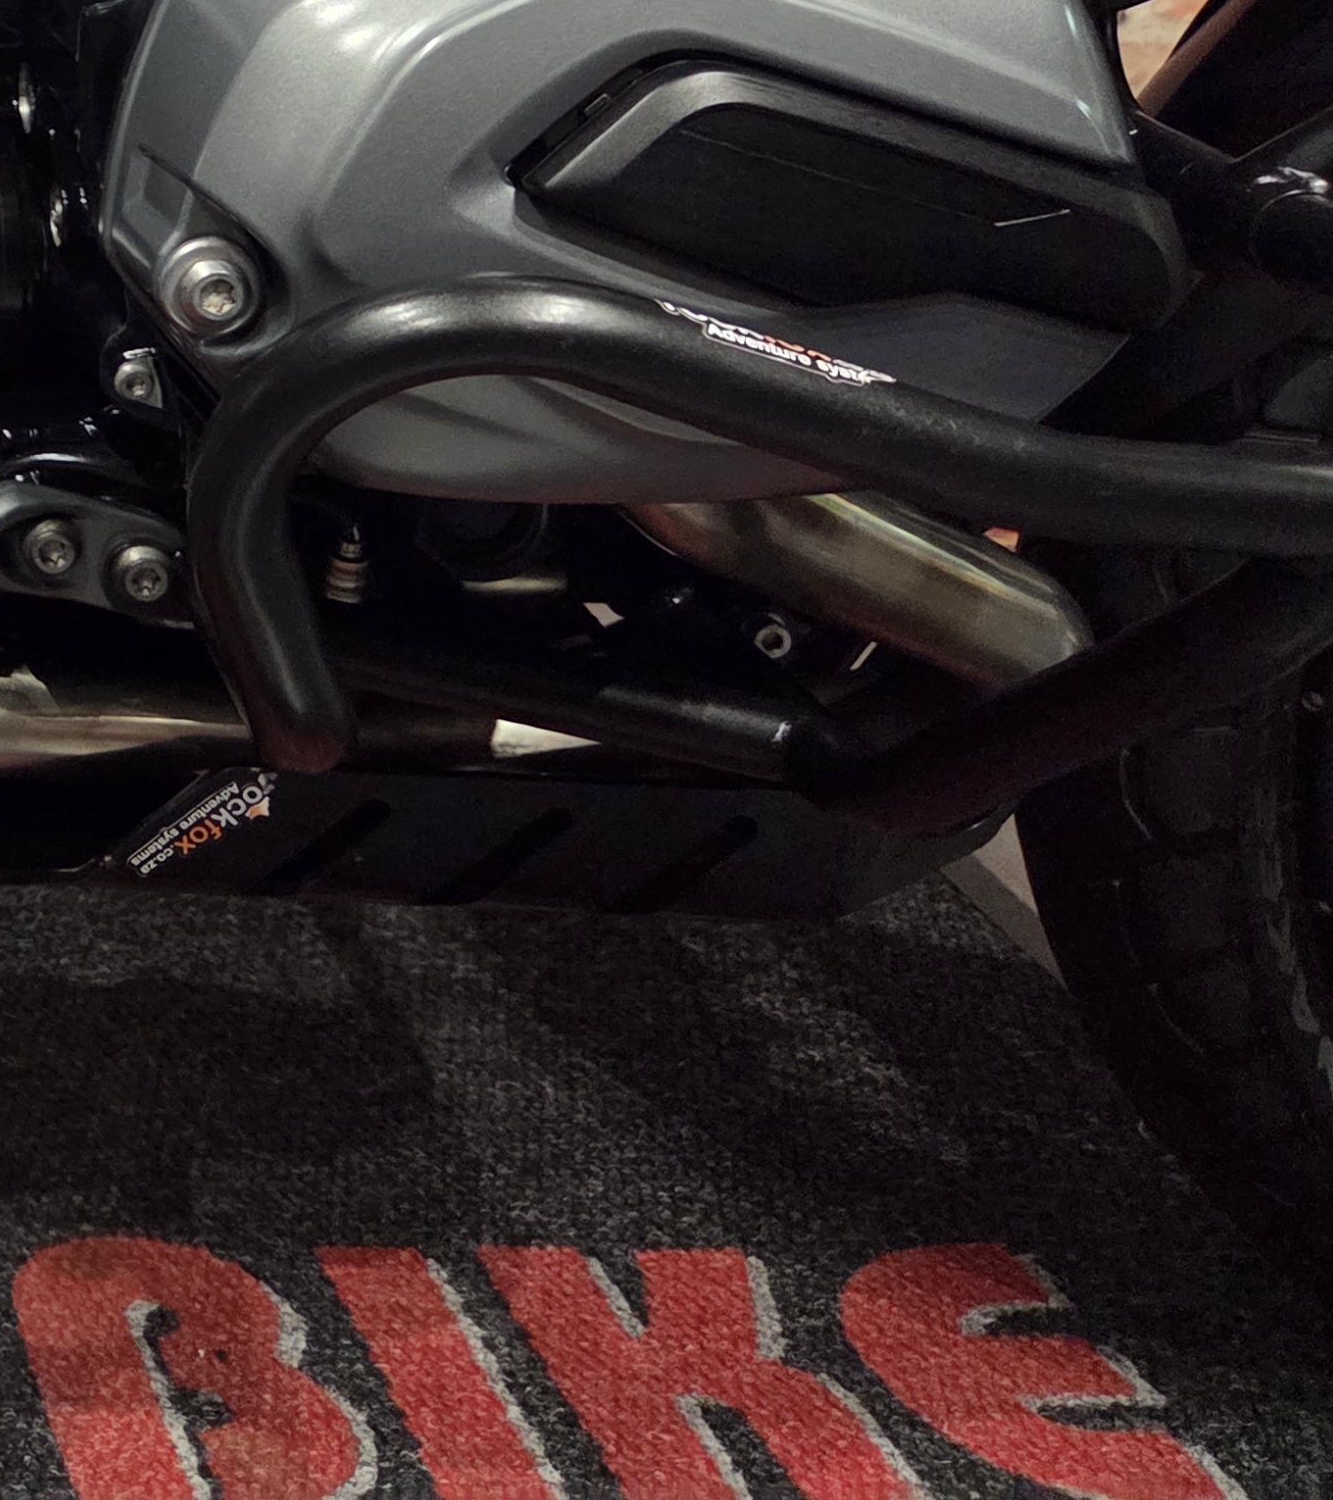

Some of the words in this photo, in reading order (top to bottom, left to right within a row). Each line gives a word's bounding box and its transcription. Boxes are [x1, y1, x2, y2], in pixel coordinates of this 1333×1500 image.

[707, 322, 812, 366] Adventure
[179, 780, 240, 830] Adventure
[130, 827, 180, 867] systems
[11, 1234, 1243, 1500] BIKE
